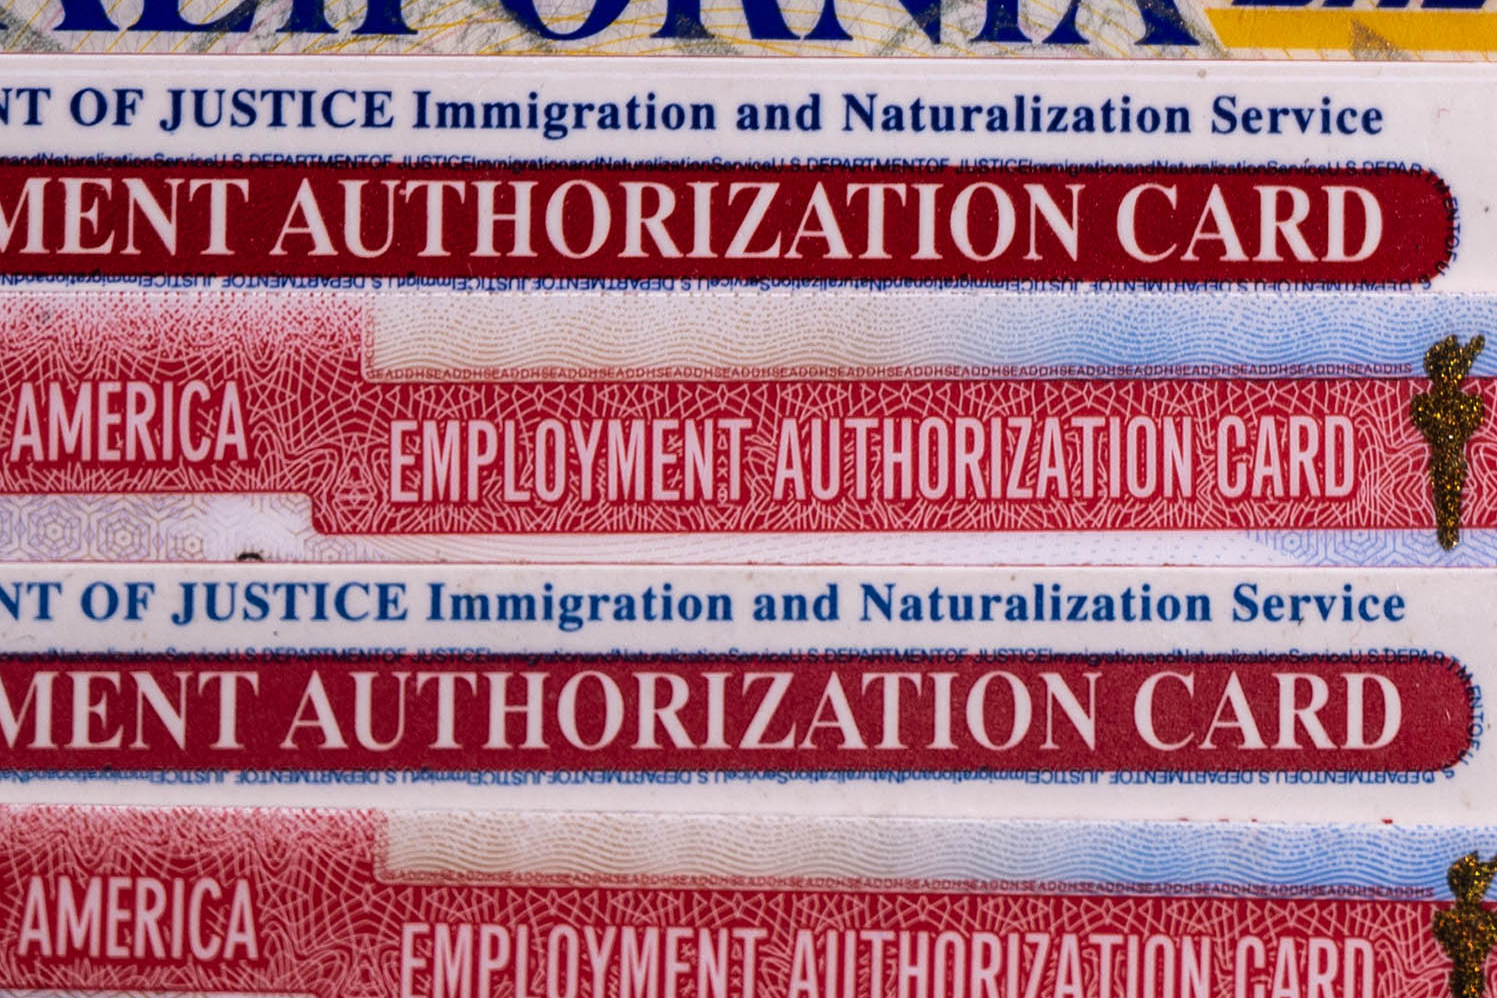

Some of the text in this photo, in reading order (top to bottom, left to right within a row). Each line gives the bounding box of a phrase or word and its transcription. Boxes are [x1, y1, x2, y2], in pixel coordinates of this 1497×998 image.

[69, 88, 144, 128] OF
[160, 89, 396, 133] JUSTICE
[411, 90, 717, 141] Immigration
[736, 91, 822, 133] and
[843, 93, 1192, 135] Naturalization
[1211, 95, 1384, 136] Service
[271, 178, 1080, 263] AUTHORIZATION
[1116, 182, 1384, 264] CARD
[9, 379, 249, 462] AMERICA
[390, 413, 1355, 504] EMPLOYMENT AUTHORIZATION CARD
[81, 582, 156, 622] OF
[171, 582, 408, 626] JUSTICE
[426, 583, 734, 632] Immigration
[753, 583, 840, 623] and
[861, 583, 1212, 623] Naturalization
[1232, 583, 1406, 624] Service
[281, 670, 1098, 752] AUTHORIZATION
[1134, 671, 1402, 752] CARD
[18, 875, 259, 962] AMERICA
[401, 921, 1376, 998] EMPLOYMENT AUTHORIZATION CARD
